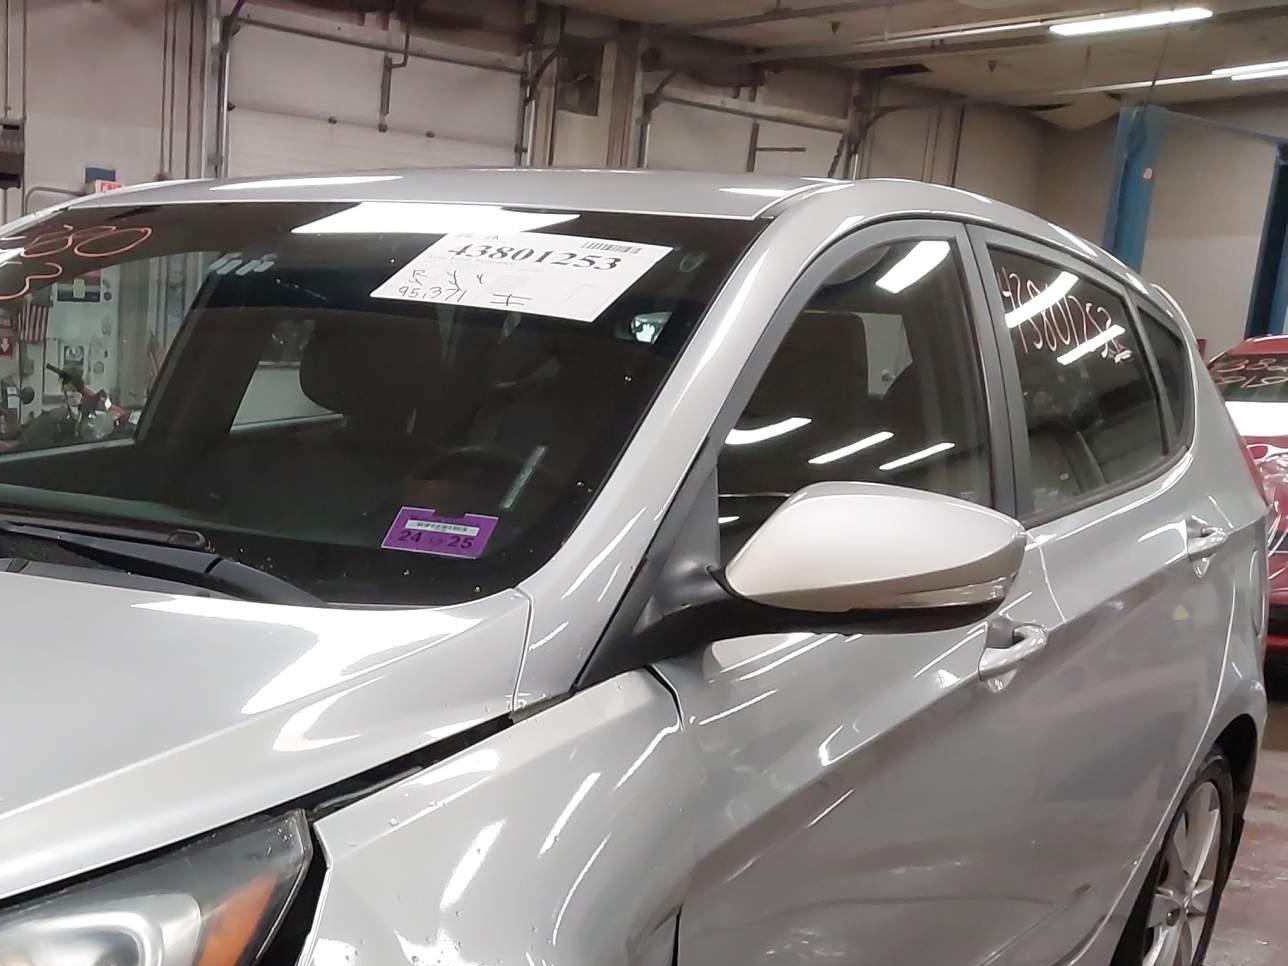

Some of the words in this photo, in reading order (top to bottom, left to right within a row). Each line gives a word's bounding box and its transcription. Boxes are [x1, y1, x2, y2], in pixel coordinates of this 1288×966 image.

[447, 243, 621, 270] 43801253
[398, 529, 422, 543] 24
[448, 535, 474, 549] 25
